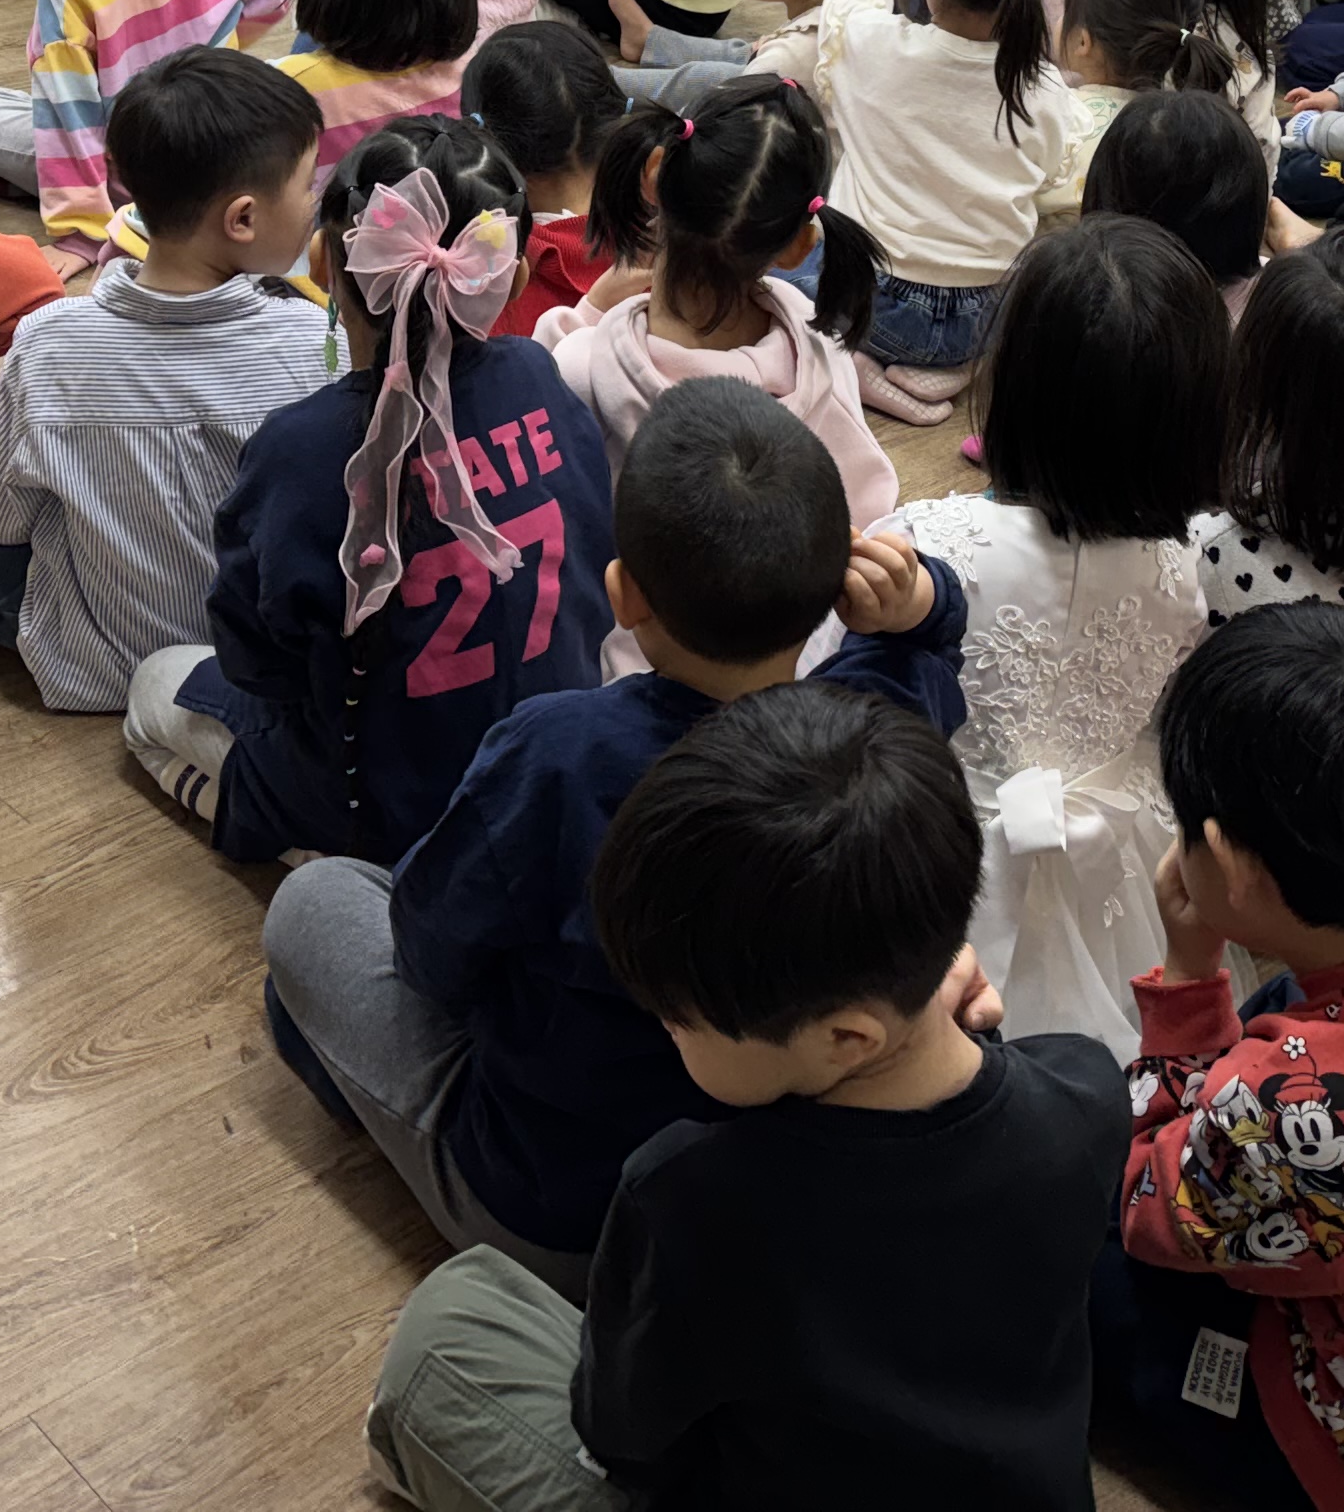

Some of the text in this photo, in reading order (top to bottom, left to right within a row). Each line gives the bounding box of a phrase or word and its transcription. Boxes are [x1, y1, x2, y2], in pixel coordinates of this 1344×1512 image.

[404, 406, 564, 520] TATE
[399, 498, 565, 699] 27
[1199, 1376, 1213, 1398] DAY
[1205, 1342, 1221, 1374] GOOD
